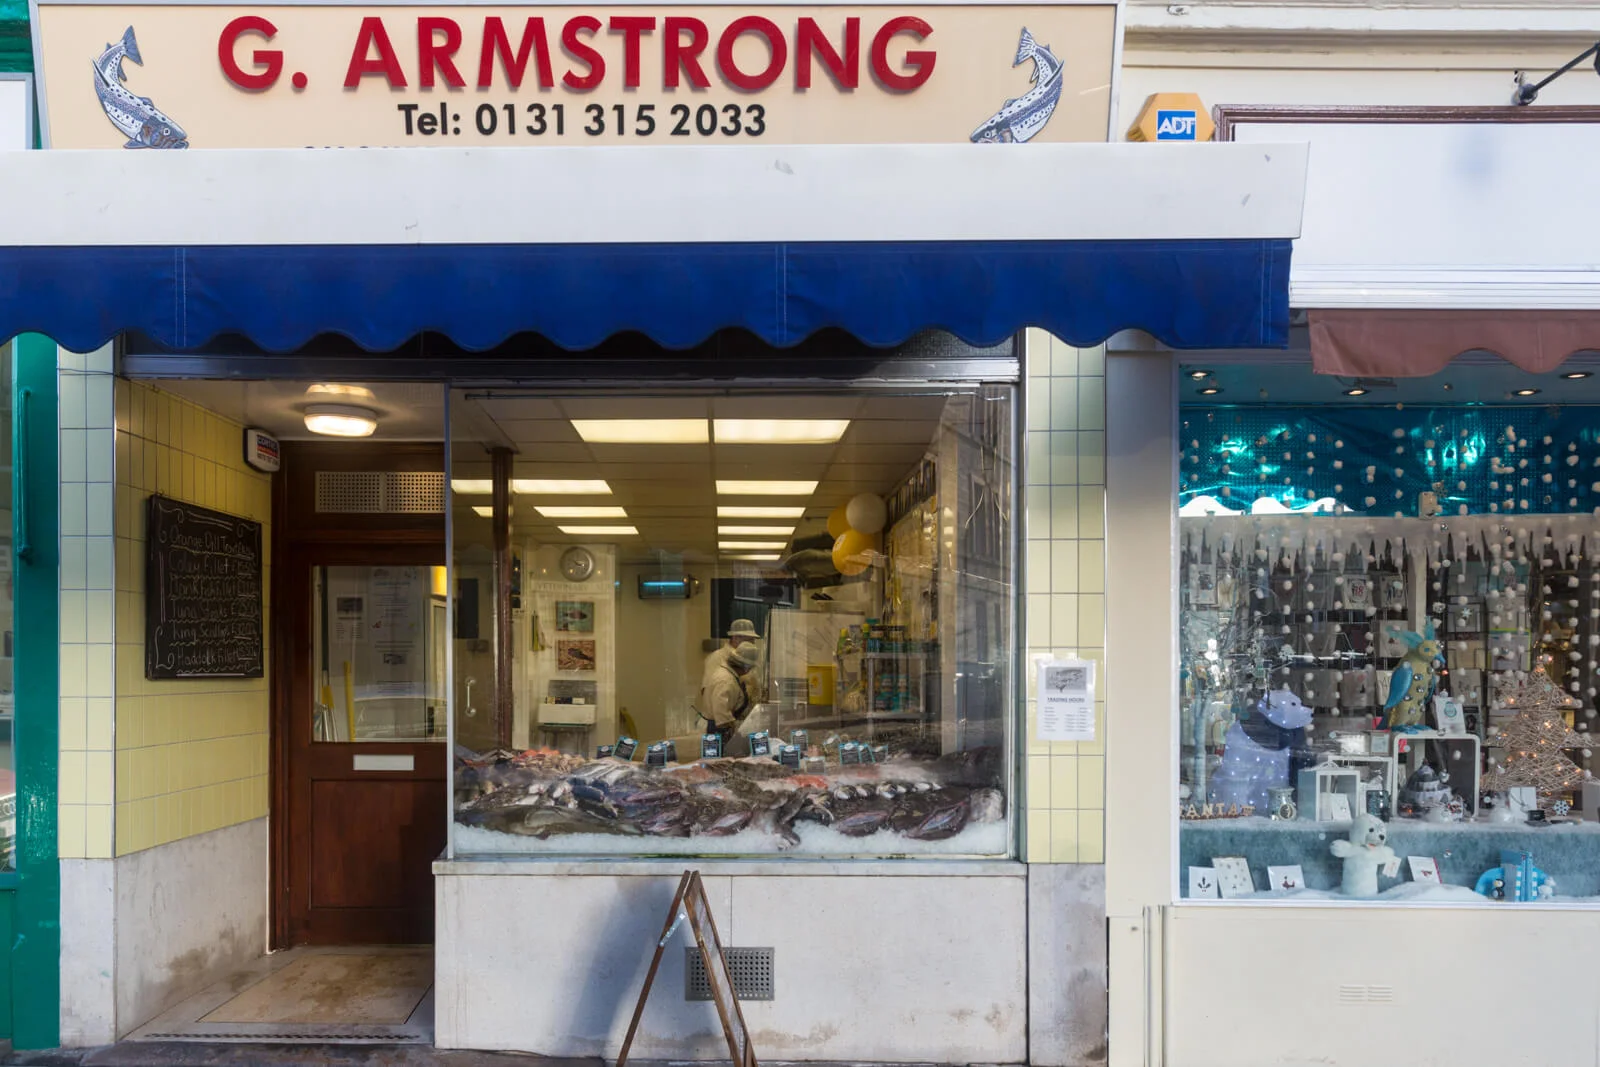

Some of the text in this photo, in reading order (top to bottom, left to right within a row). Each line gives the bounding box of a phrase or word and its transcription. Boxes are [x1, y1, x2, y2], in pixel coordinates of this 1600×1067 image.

[218, 15, 937, 90] G. ARMSTRONG
[398, 103, 766, 137] Tel: 0131 315 2033
[1158, 116, 1197, 135] ADT
